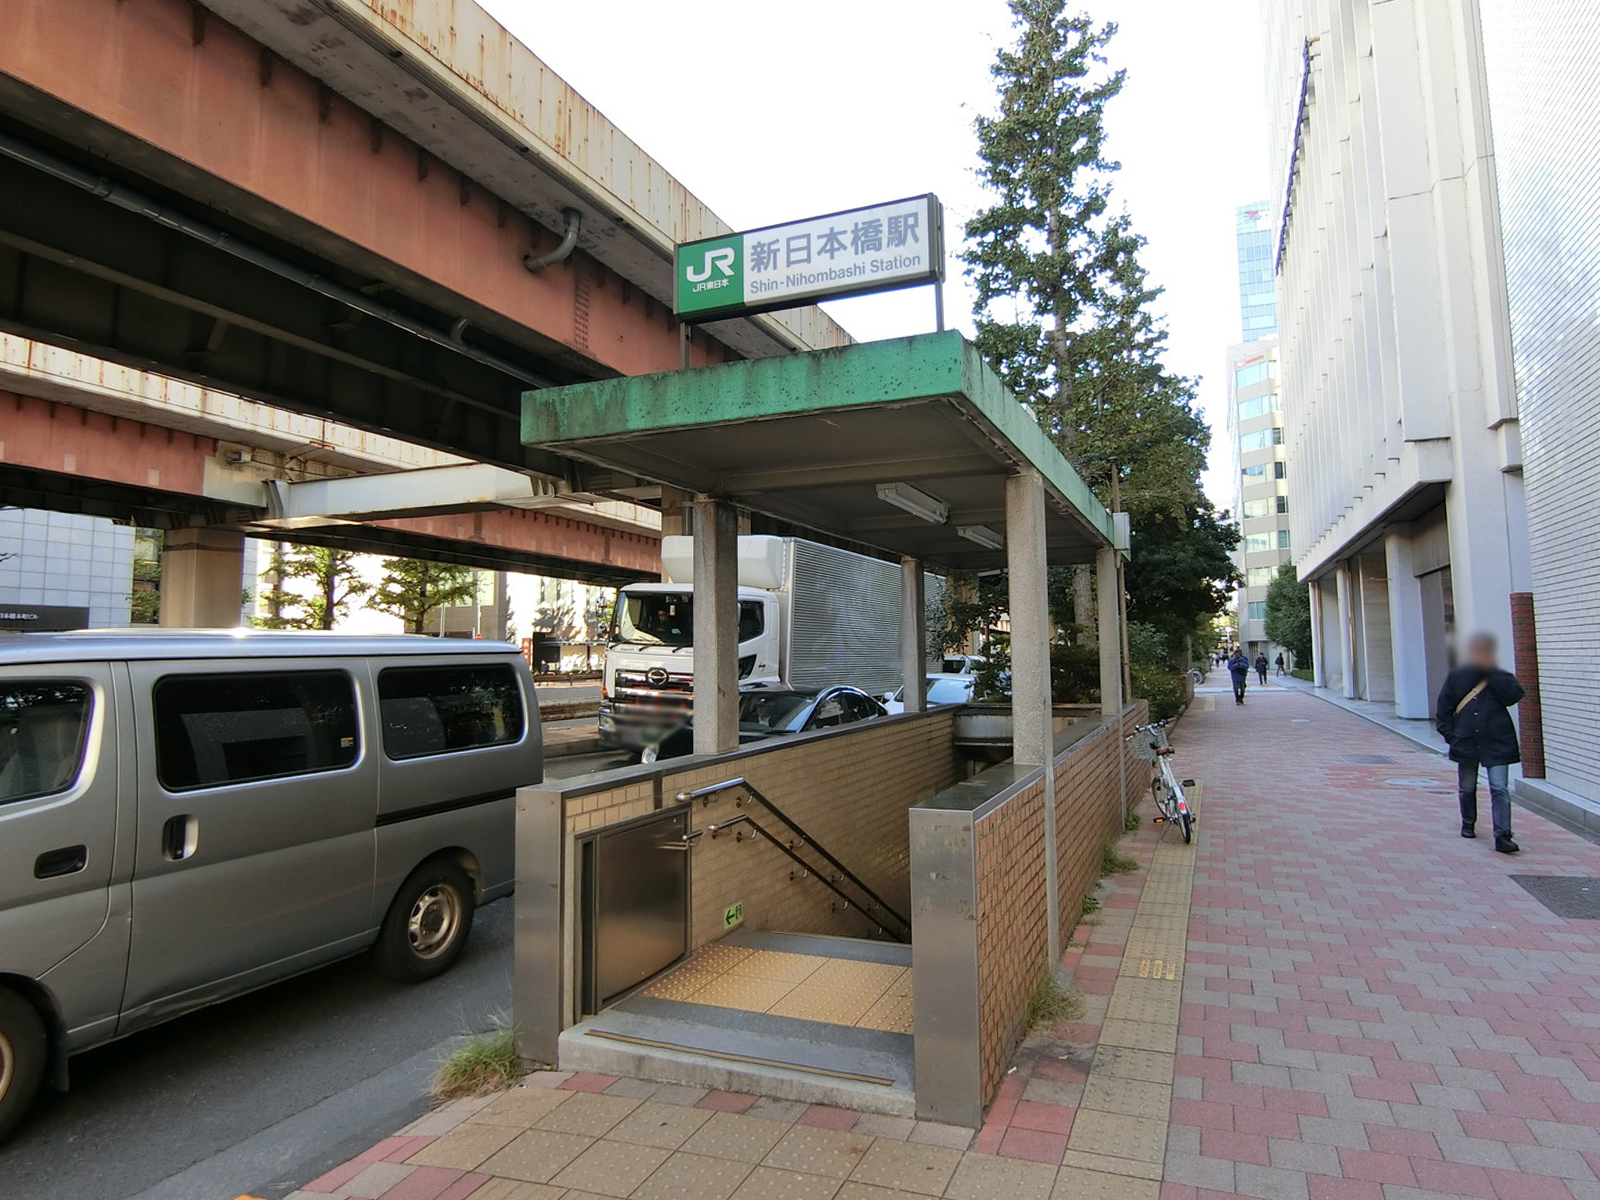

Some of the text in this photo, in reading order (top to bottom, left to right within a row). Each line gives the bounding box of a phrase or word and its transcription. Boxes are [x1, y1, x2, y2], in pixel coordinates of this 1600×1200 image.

[750, 212, 920, 273] 新日本橋駅
[686, 246, 735, 283] JR
[750, 255, 921, 294] Shin-Nihombashi Station
[692, 278, 729, 293] JR東日本
